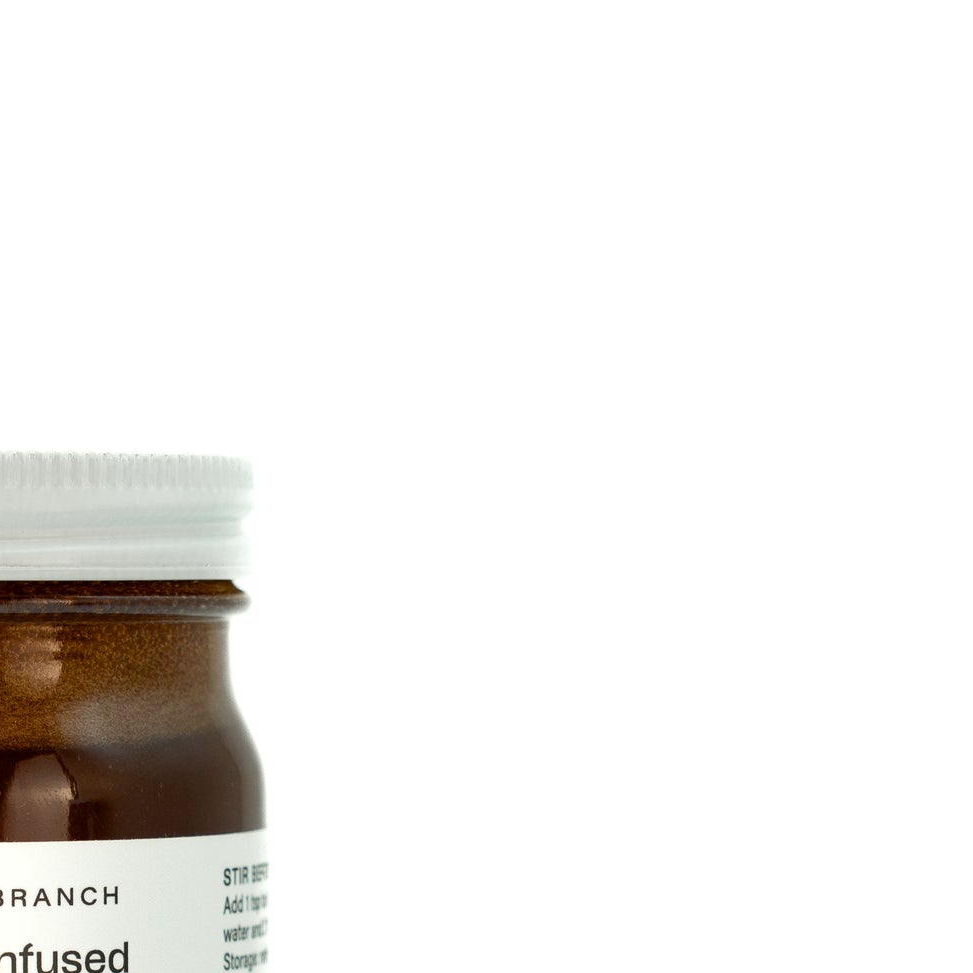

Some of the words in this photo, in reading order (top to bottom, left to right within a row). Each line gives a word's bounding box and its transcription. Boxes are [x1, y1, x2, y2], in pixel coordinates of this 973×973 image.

[223, 866, 249, 886] STIR
[223, 894, 244, 915] Add
[223, 924, 249, 943] water
